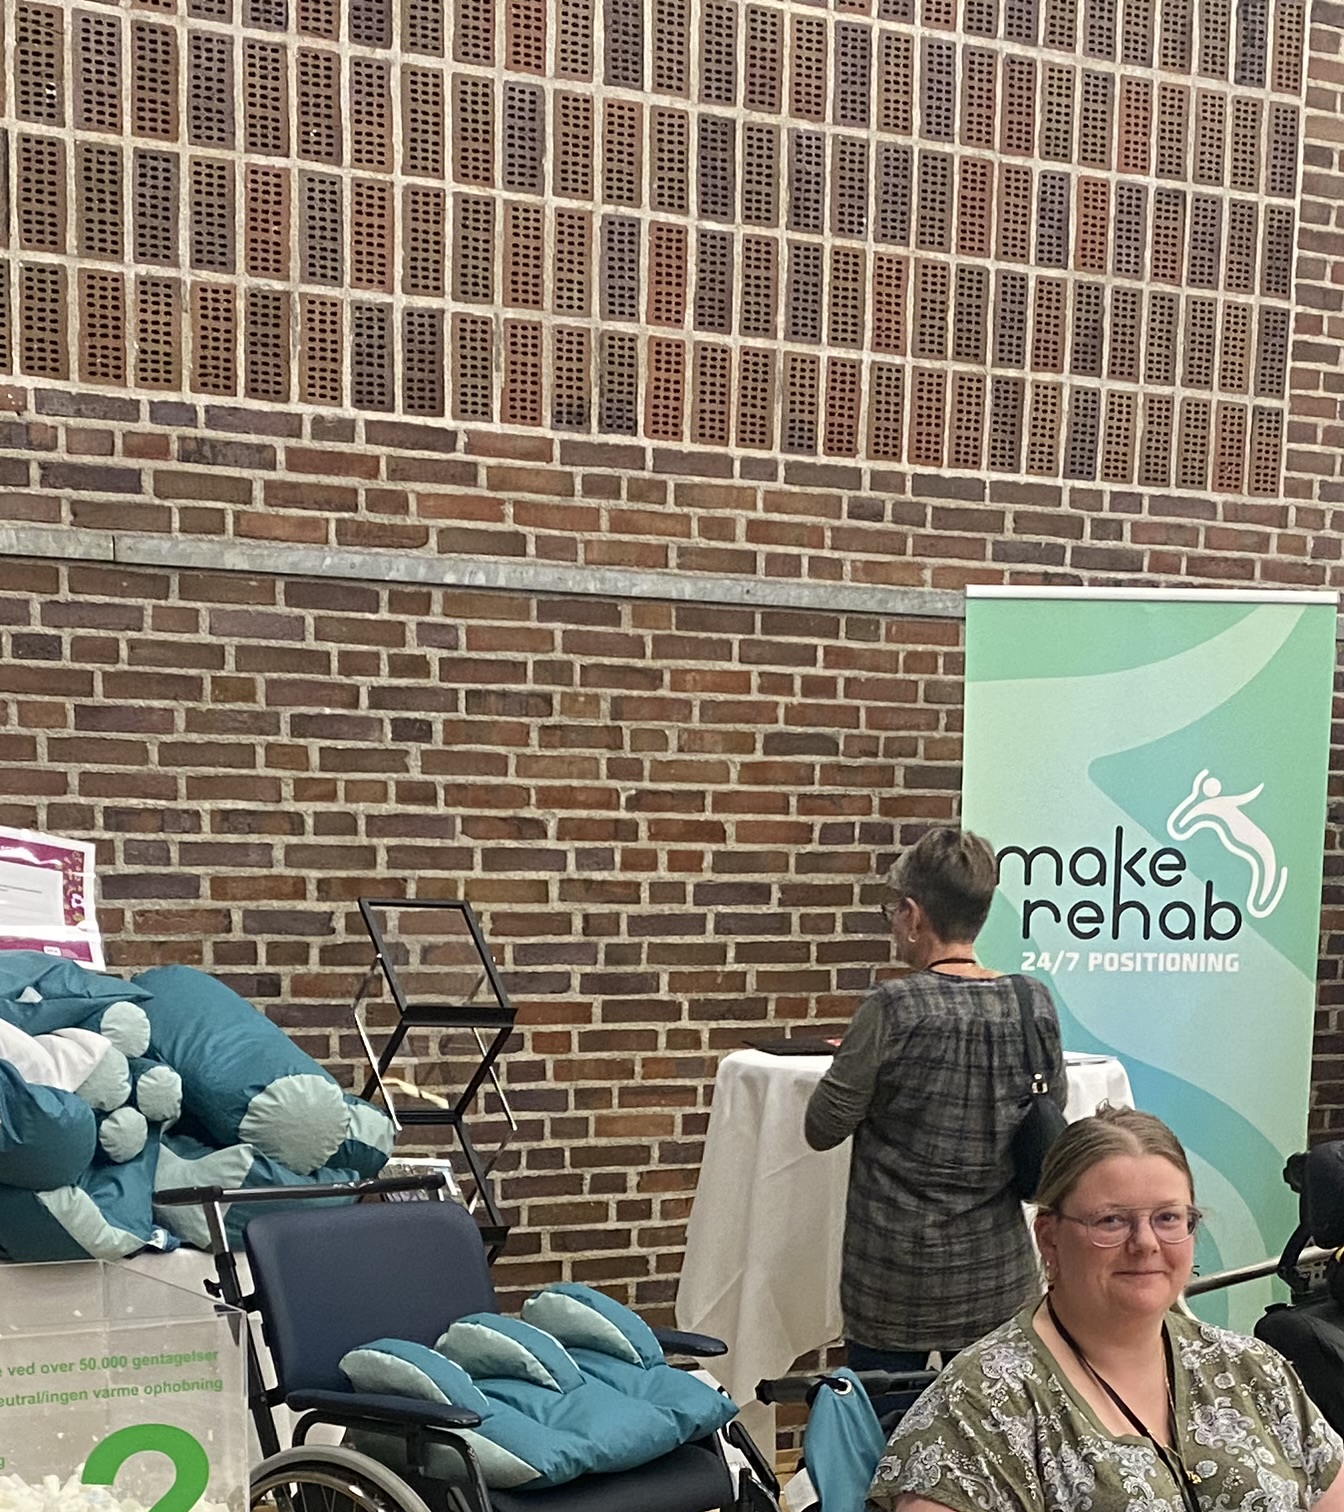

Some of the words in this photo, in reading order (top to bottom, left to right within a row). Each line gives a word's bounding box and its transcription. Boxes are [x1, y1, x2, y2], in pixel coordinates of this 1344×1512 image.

[996, 826, 1187, 887] make
[1022, 880, 1243, 941] rehab
[1020, 952, 1080, 973] 24/7
[1088, 952, 1239, 973] POSITIONING
[8, 1362, 35, 1376] ved
[41, 1362, 74, 1374] over
[79, 1356, 127, 1371] 50.000
[132, 1350, 219, 1370] gentagelser
[93, 1385, 139, 1399] varme
[144, 1378, 223, 1397] ophobning
